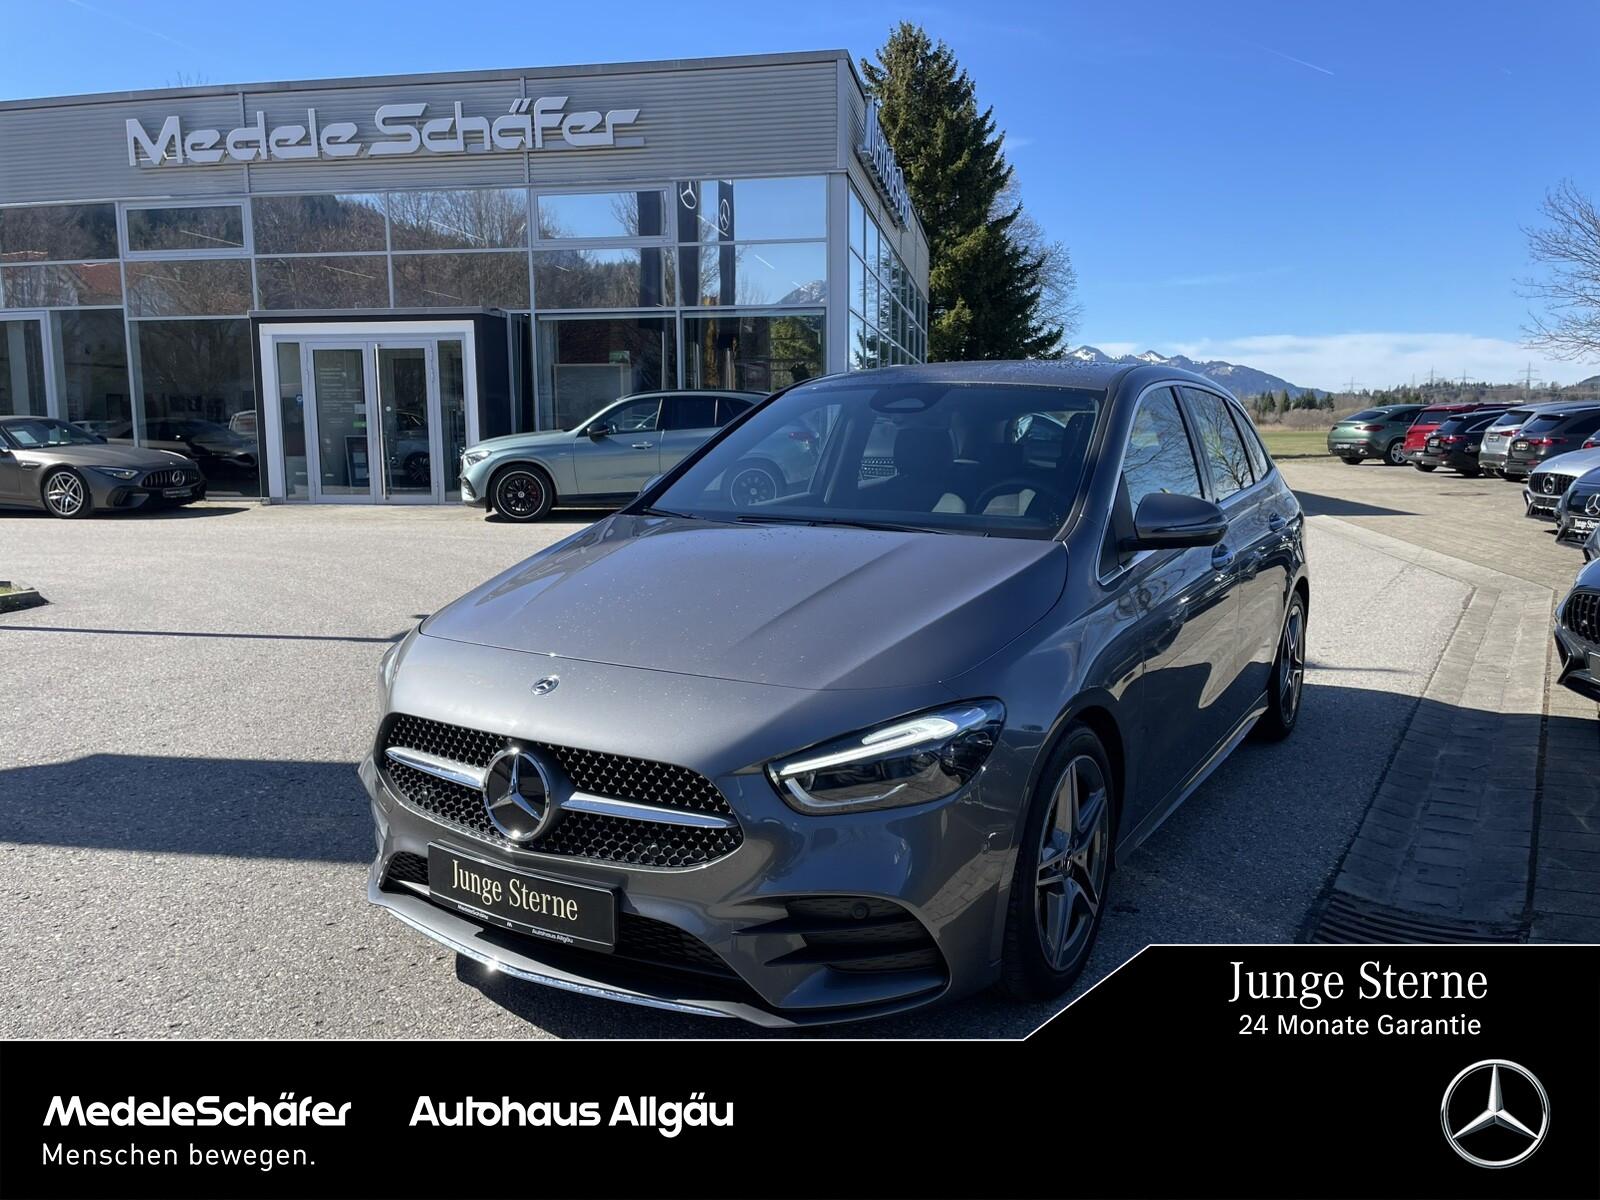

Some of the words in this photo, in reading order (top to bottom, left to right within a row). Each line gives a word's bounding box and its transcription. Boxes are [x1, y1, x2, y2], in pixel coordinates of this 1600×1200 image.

[125, 108, 363, 166] Medele
[367, 96, 642, 158] Schäfer
[451, 859, 502, 905] Junge
[508, 878, 578, 921] Sterne
